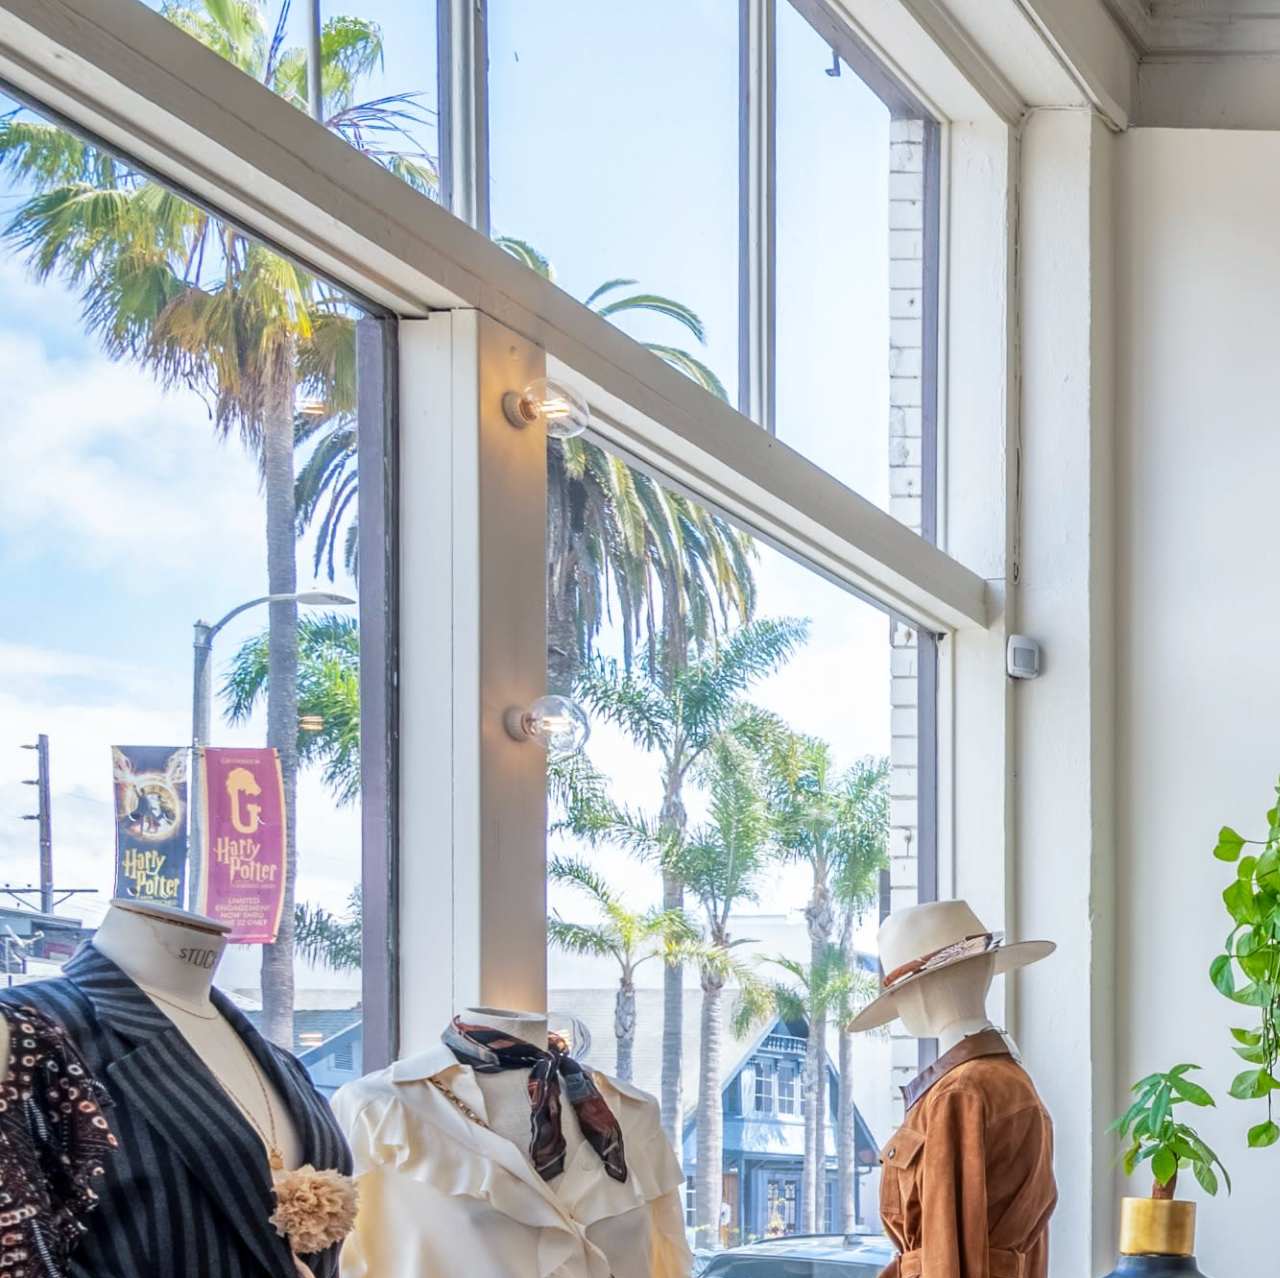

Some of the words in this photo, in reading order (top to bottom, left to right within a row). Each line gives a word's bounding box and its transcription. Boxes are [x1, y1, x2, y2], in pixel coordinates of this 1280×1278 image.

[122, 847, 167, 879] Harry
[213, 836, 261, 864] Harry
[230, 856, 278, 882] Potter
[136, 869, 180, 899] Potter
